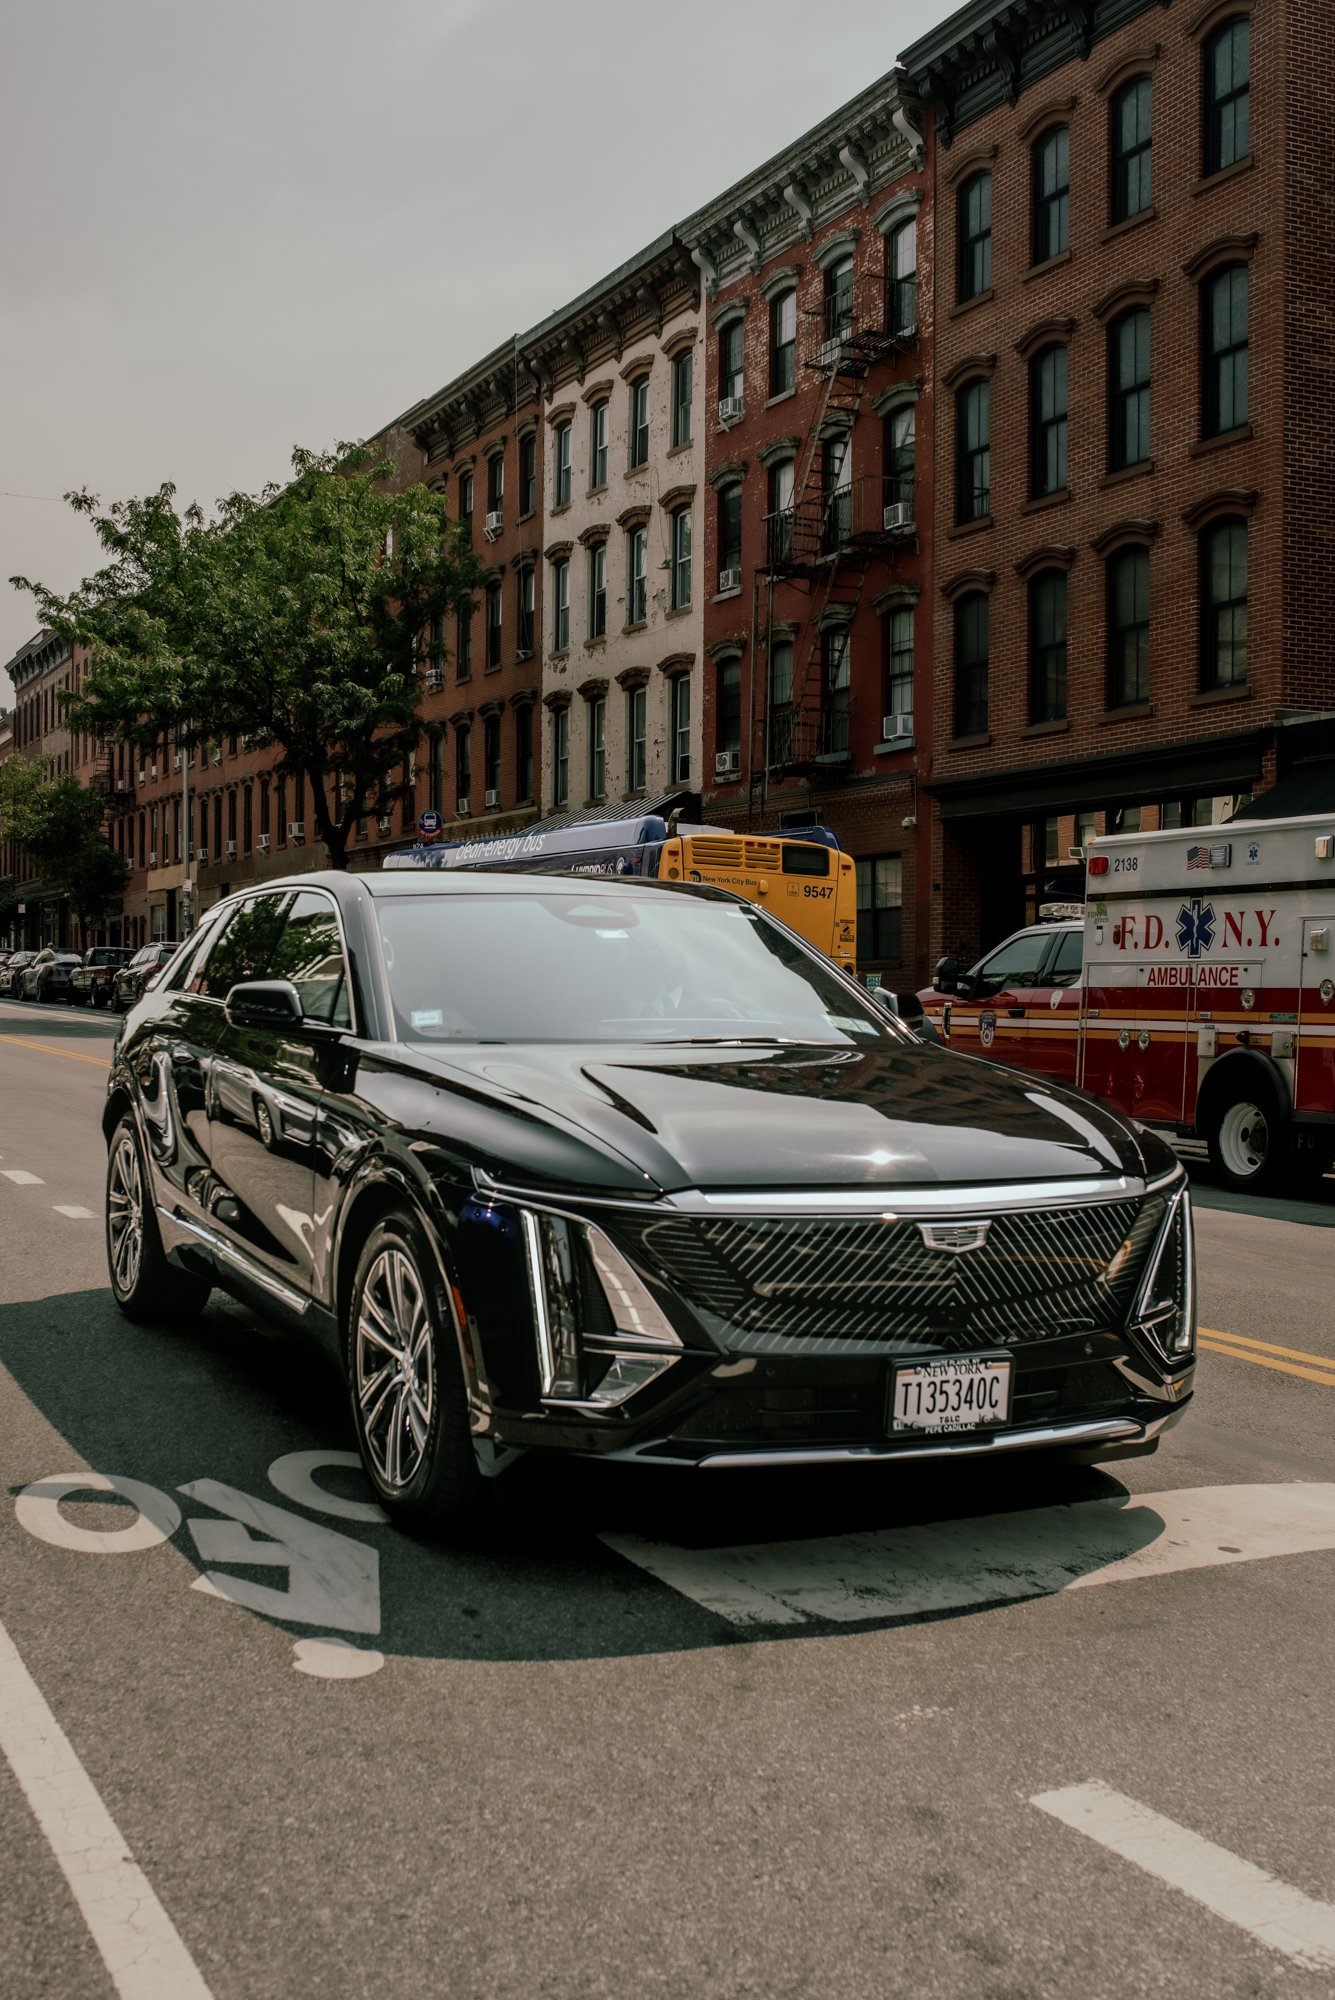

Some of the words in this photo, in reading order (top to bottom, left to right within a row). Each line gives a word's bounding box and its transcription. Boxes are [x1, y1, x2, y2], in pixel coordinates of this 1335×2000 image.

[456, 841, 522, 860] clean-energy
[522, 831, 546, 853] bus
[1114, 857, 1138, 872] 2138
[718, 876, 731, 884] York
[732, 877, 745, 886] City
[745, 878, 757, 886] Bus
[803, 885, 833, 899] 9547
[1119, 915, 1170, 949] F.D.
[1221, 909, 1280, 948] N.Y.
[1147, 966, 1239, 986] AMBULANCE
[923, 1364, 949, 1378] NEW
[949, 1362, 982, 1376] YORK
[902, 1376, 1000, 1416] T135340C
[925, 1424, 942, 1434] PEPE
[943, 1422, 976, 1433] CADILLAC
